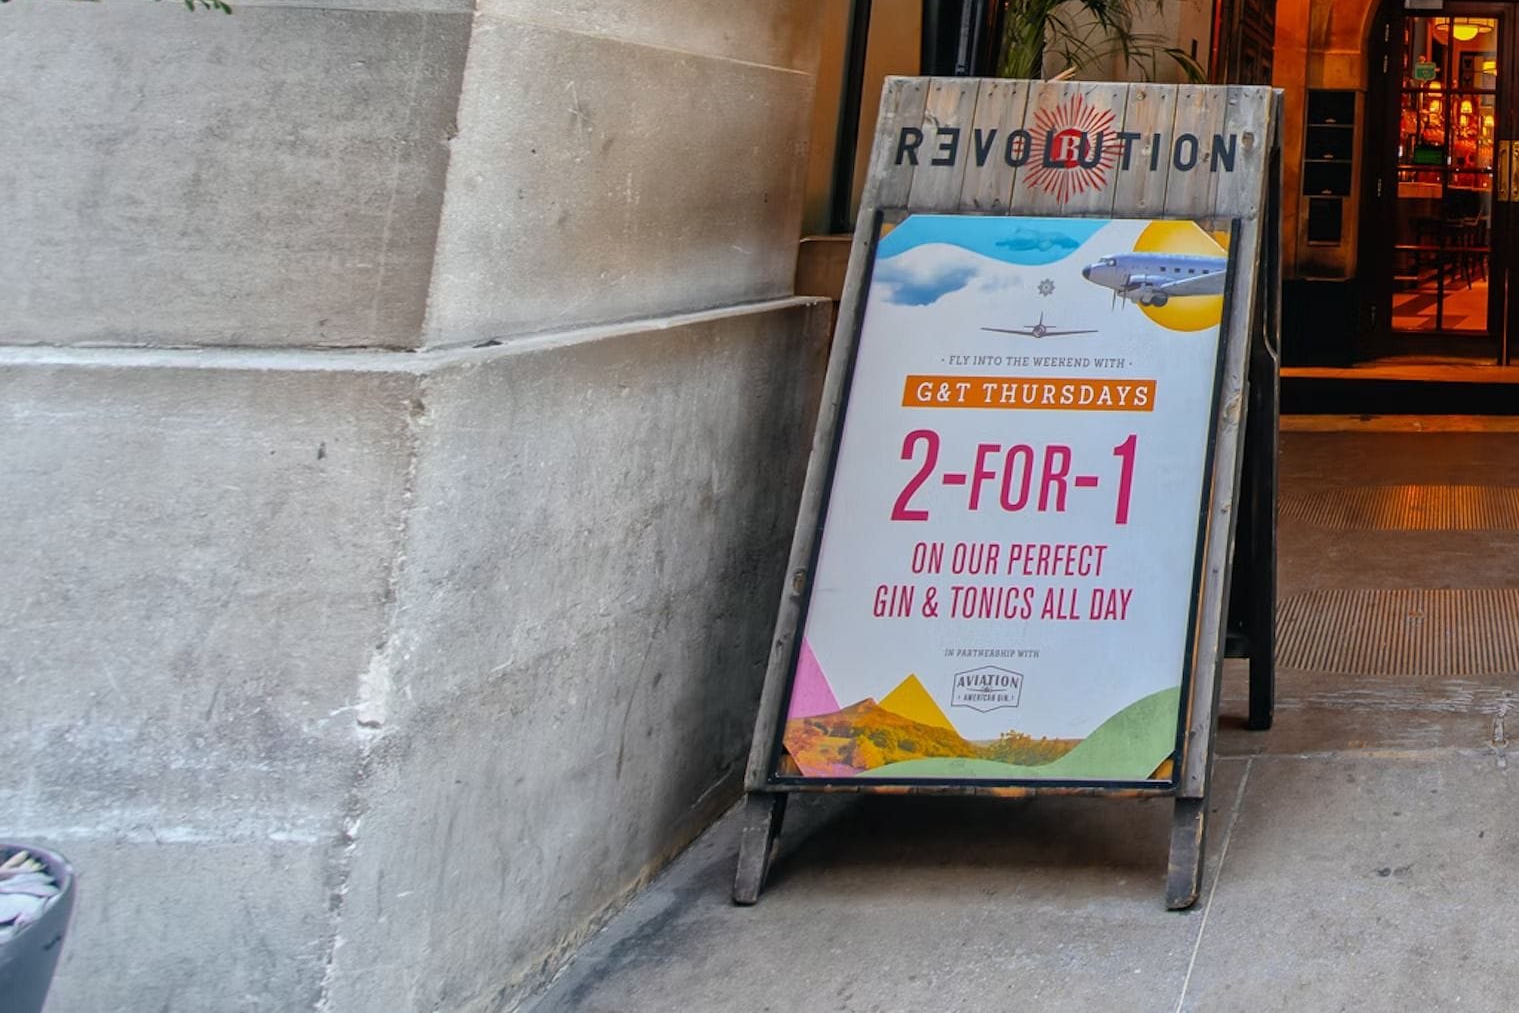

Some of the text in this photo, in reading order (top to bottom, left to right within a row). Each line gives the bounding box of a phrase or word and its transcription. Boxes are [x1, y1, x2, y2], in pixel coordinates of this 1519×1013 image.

[949, 355, 1126, 369] FLY INTO THE WEEKEND WITH
[916, 381, 1149, 406] G&T THURSDAYS
[890, 429, 1138, 525] 2-FOR-1
[911, 542, 1108, 577] ON OUR PERFECT
[873, 585, 1132, 621] GIN & TONICS ALL DAY
[956, 649, 1015, 658] PARTNERSHIP
[1017, 650, 1040, 659] WITH
[956, 674, 1020, 689] AVIATION
[963, 693, 996, 701] AMERICAN
